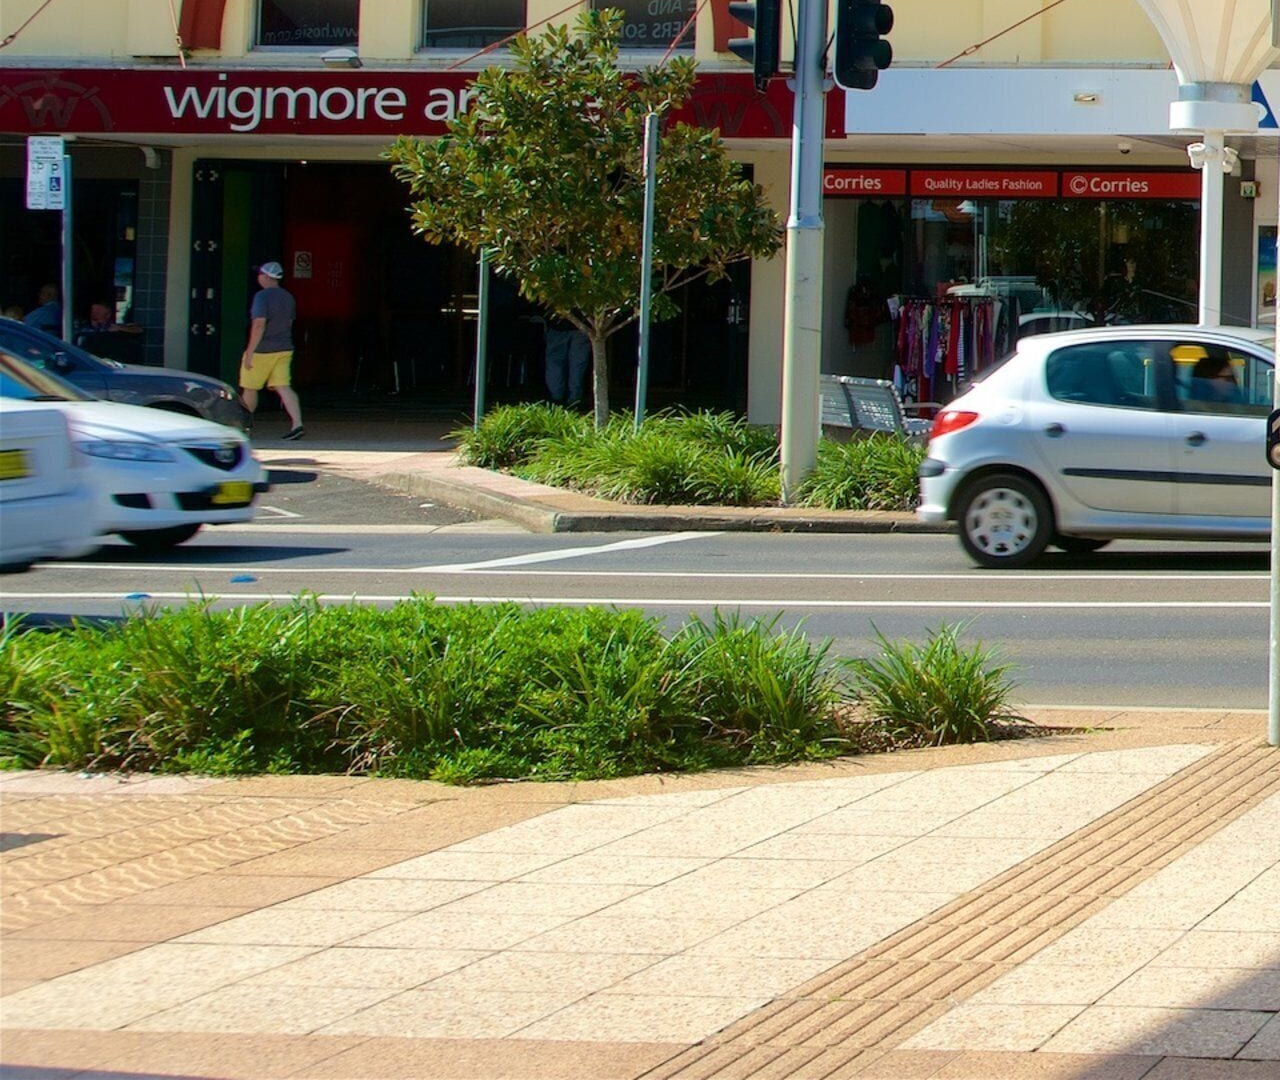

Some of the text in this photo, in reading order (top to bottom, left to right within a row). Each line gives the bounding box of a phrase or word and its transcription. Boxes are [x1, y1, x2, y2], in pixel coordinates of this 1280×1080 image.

[164, 73, 407, 131] wigmore
[823, 174, 882, 191] Corries
[925, 177, 1043, 192] Quality Ladies Fashion
[1090, 177, 1149, 193] Corries
